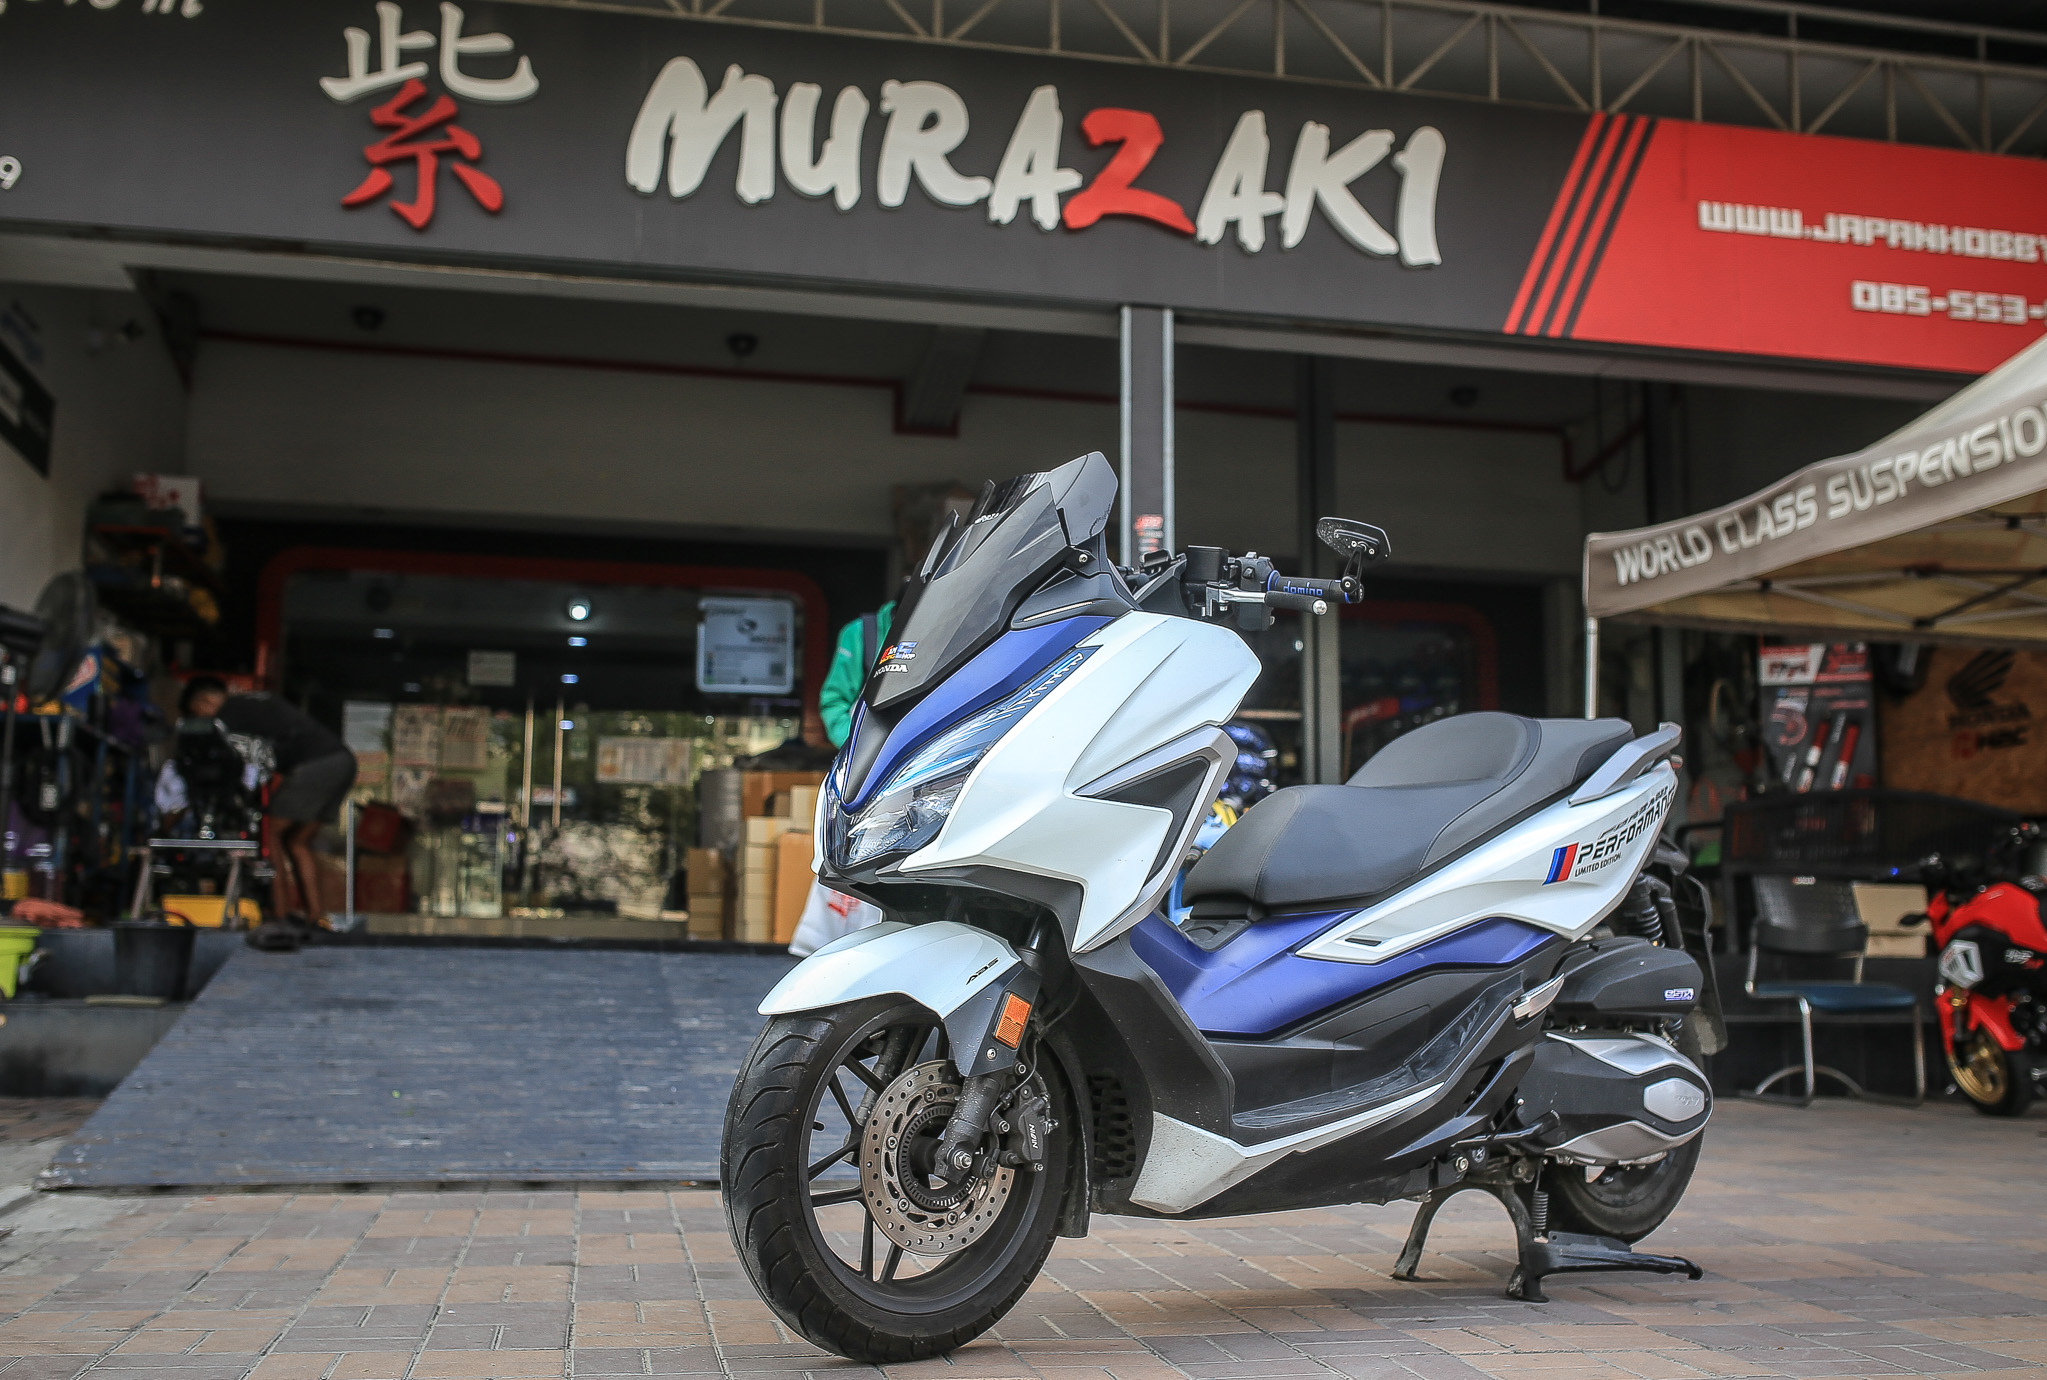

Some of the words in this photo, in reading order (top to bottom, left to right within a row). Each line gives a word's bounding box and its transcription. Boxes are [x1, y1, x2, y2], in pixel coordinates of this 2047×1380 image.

[319, 1, 540, 230] 紫
[625, 56, 1446, 267] MURAZAKI
[1851, 279, 2047, 326] 085-553-
[1613, 524, 1714, 586] WORLD
[1714, 484, 1819, 555] CLASS
[1826, 400, 2047, 520] SUSPENSIO
[1283, 580, 1323, 597] domino
[1574, 861, 1599, 878] LIMITED
[1600, 852, 1622, 869] EDITION
